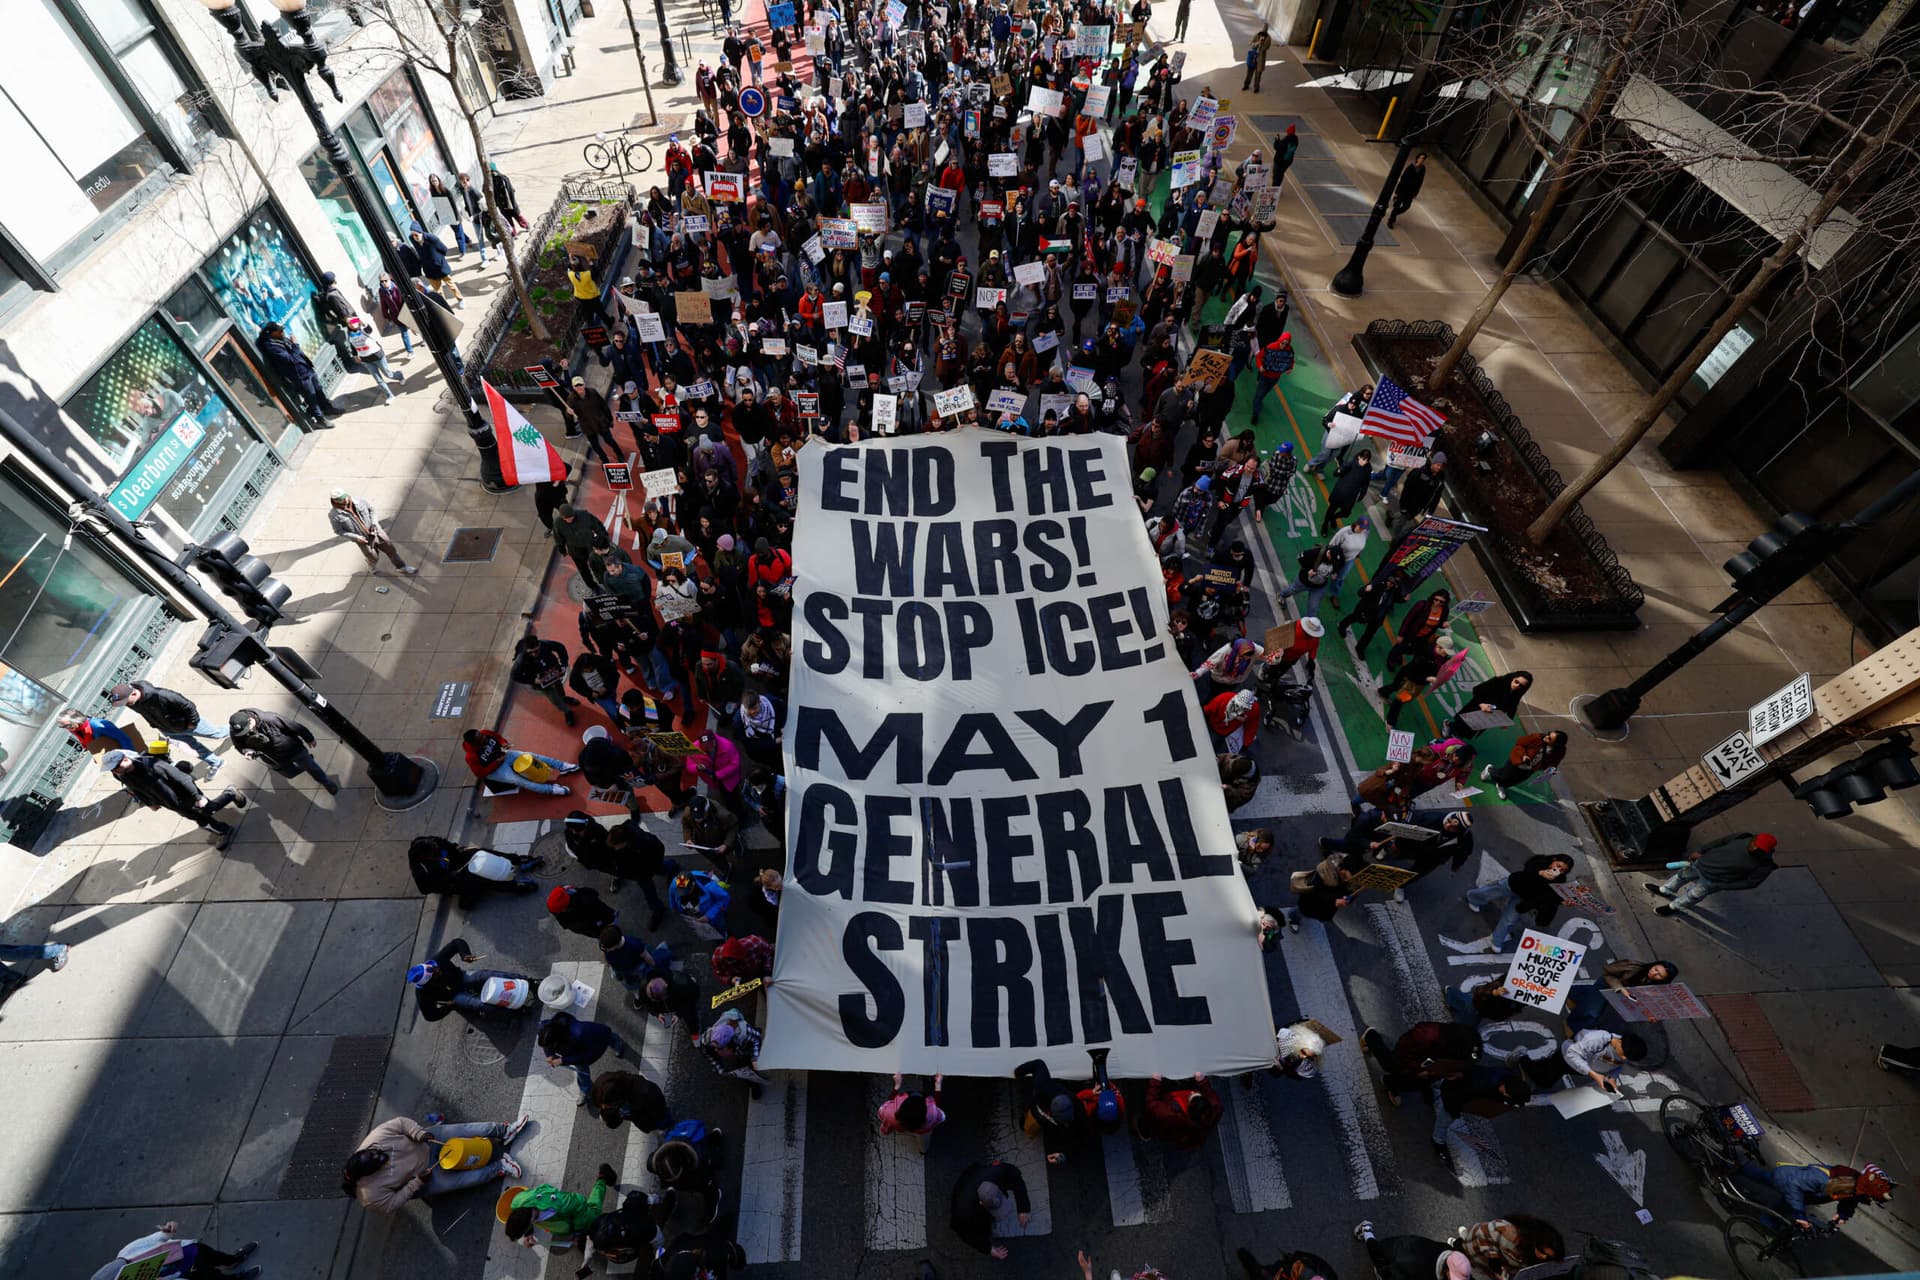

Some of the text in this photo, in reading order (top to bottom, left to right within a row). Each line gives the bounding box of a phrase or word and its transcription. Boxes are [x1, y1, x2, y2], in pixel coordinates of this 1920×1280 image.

[86, 175, 111, 199] m.edu
[1147, 249, 1175, 266] KINGS
[1157, 240, 1173, 254] NO
[120, 446, 177, 507] Dearborn
[171, 427, 228, 500] SURROUND YOURSELF
[820, 441, 1113, 518] END THE
[851, 516, 1097, 599] WARS!
[802, 586, 1165, 681] STOP ICE!
[1780, 691, 1794, 723] GREEN
[1794, 679, 1808, 719] LEFT ON
[1754, 711, 1768, 735] ONLY
[1768, 700, 1781, 732] ARROW
[794, 690, 1197, 786] MAY 1
[1732, 738, 1760, 768] ONE
[1389, 748, 1409, 760] WAR
[1720, 744, 1748, 773] WAY
[794, 777, 1235, 907] GENERAL
[838, 890, 1212, 1049] STRIKE
[1518, 962, 1536, 974] NO
[1526, 952, 1568, 972] HURTS
[1511, 977, 1558, 998] ORANGE
[1525, 973, 1550, 987] YOU
[1734, 1105, 1758, 1135] DEMAND
